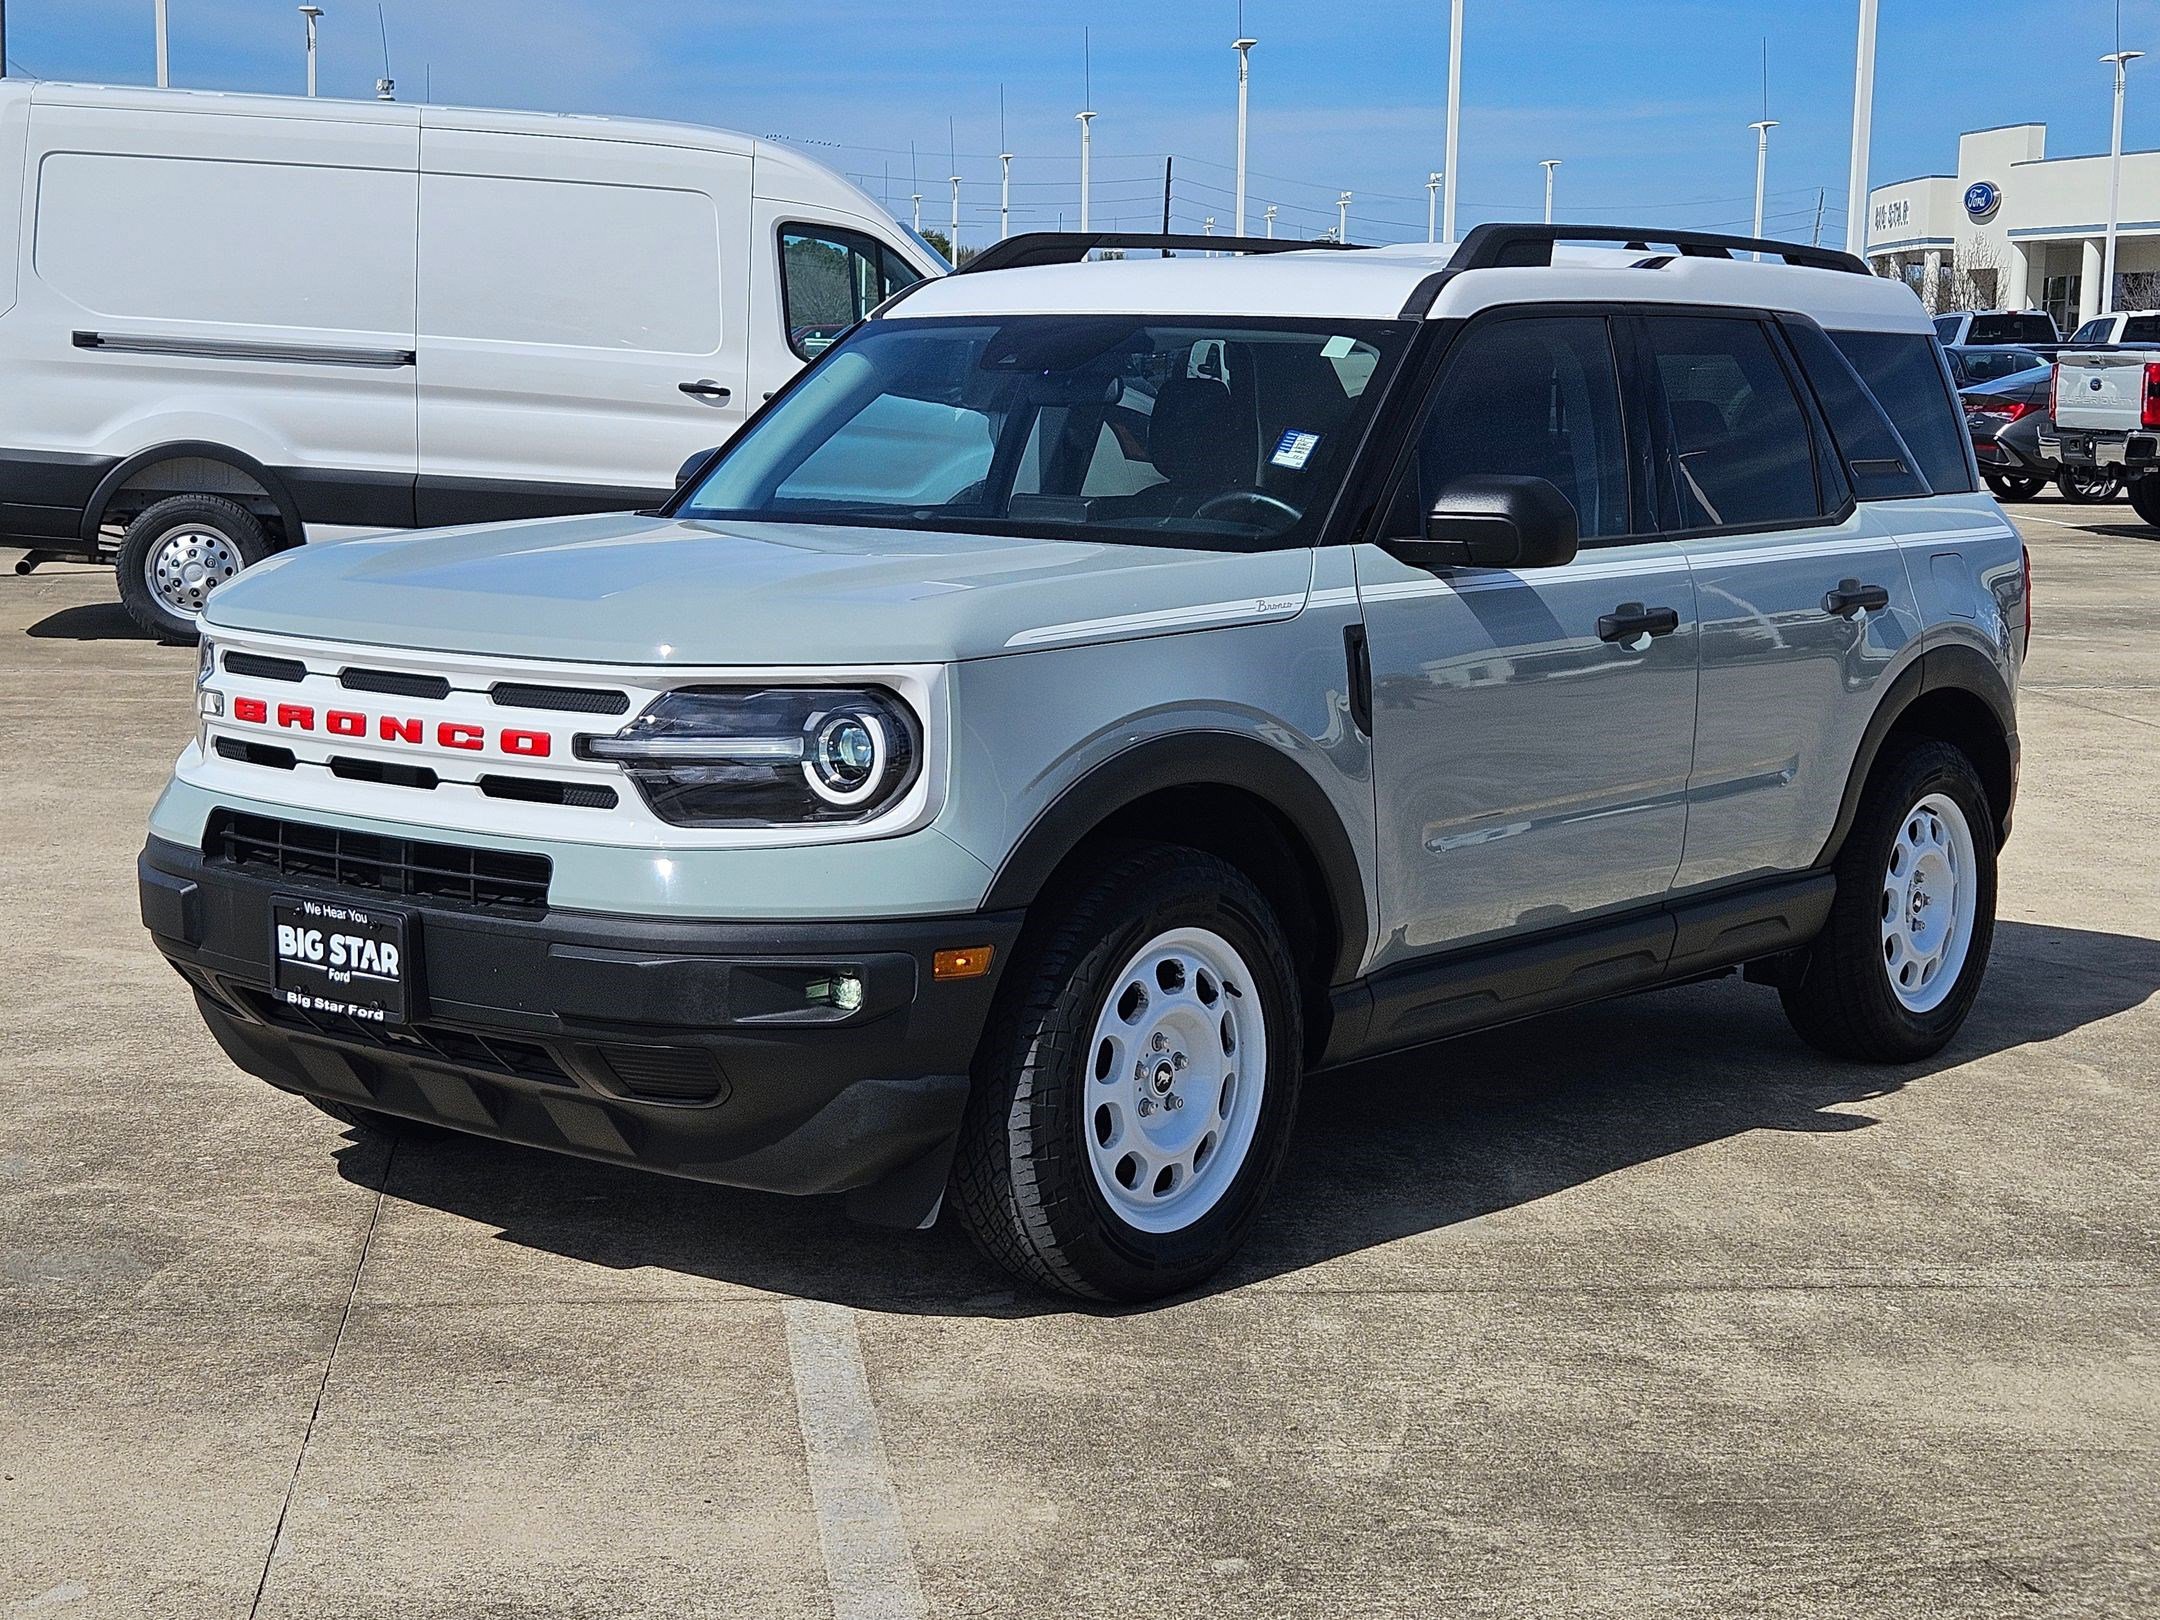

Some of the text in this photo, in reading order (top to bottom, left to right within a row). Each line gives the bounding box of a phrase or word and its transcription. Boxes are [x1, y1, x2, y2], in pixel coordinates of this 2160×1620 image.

[1255, 599, 1293, 612] Bronco
[234, 695, 552, 758] BRONCO
[303, 901, 368, 924] We Hear You
[277, 924, 399, 976] BIG STAR
[328, 968, 351, 983] Ford
[286, 991, 384, 1021] Big Star Ford
